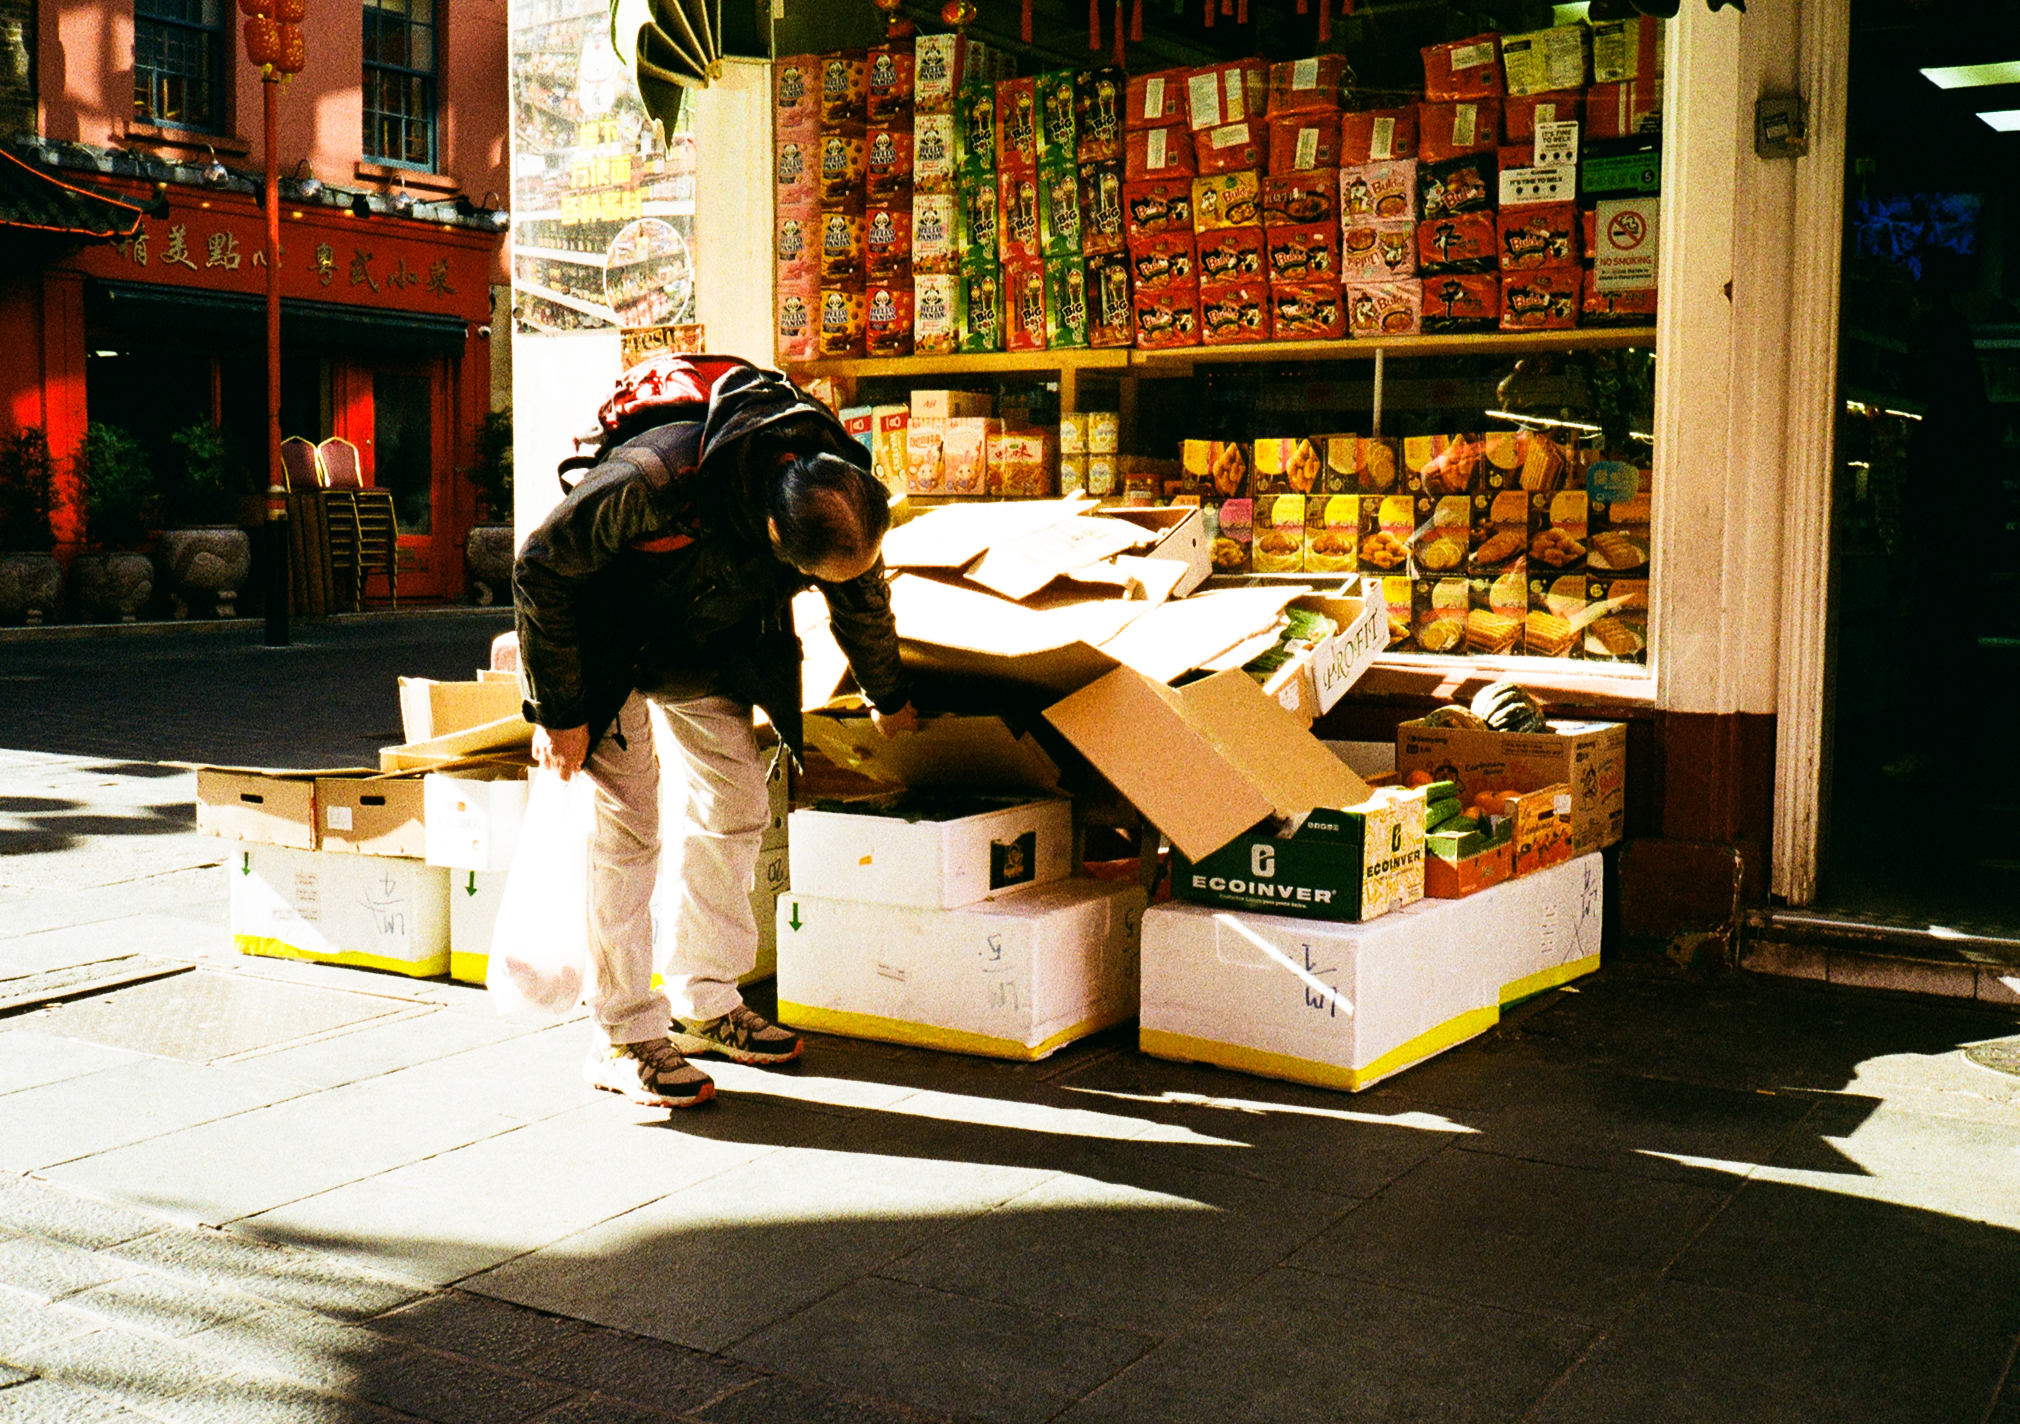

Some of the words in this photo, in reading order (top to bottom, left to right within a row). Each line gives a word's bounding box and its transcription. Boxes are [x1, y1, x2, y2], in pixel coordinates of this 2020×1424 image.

[921, 64, 945, 74] HELLO
[871, 70, 895, 80] HELLO
[920, 72, 946, 81] PANDA
[825, 77, 848, 86] HELLO
[870, 78, 897, 86] PANDA
[824, 84, 849, 92] PANDA
[870, 149, 895, 158] HELLO
[920, 144, 944, 154] HELLO
[824, 154, 847, 163] HELLO
[869, 156, 897, 165] PANDA
[919, 152, 945, 160] PANDA
[823, 161, 848, 171] PANDA
[1644, 171, 1652, 182] 5
[1442, 186, 1486, 209] Bulak
[870, 227, 895, 237] HELLO
[918, 226, 942, 235] HELLO
[825, 231, 850, 241] HELLO
[869, 235, 896, 243] PANDA
[917, 232, 943, 241] PANDA
[824, 239, 851, 248] PANDA
[1433, 222, 1462, 262] 辛
[1140, 257, 1169, 275] Buld
[1600, 258, 1612, 266] NO
[1613, 256, 1651, 265] SMOKING
[1438, 278, 1468, 318] 辛
[1512, 292, 1549, 309] Bulda
[824, 308, 847, 318] HELLO
[870, 306, 895, 315] HELLO
[920, 305, 945, 314] HELLO
[1282, 302, 1314, 318] Bldak
[782, 311, 807, 320] HELLO
[823, 315, 848, 325] PANDA
[869, 313, 897, 322] PANDA
[919, 312, 946, 320] PANDA
[1142, 310, 1173, 328] Buldk
[781, 318, 808, 327] PANDA
[1323, 607, 1379, 691] PROFIT
[1367, 850, 1421, 877] ECOINVER
[1192, 874, 1332, 903] ECOINVER
